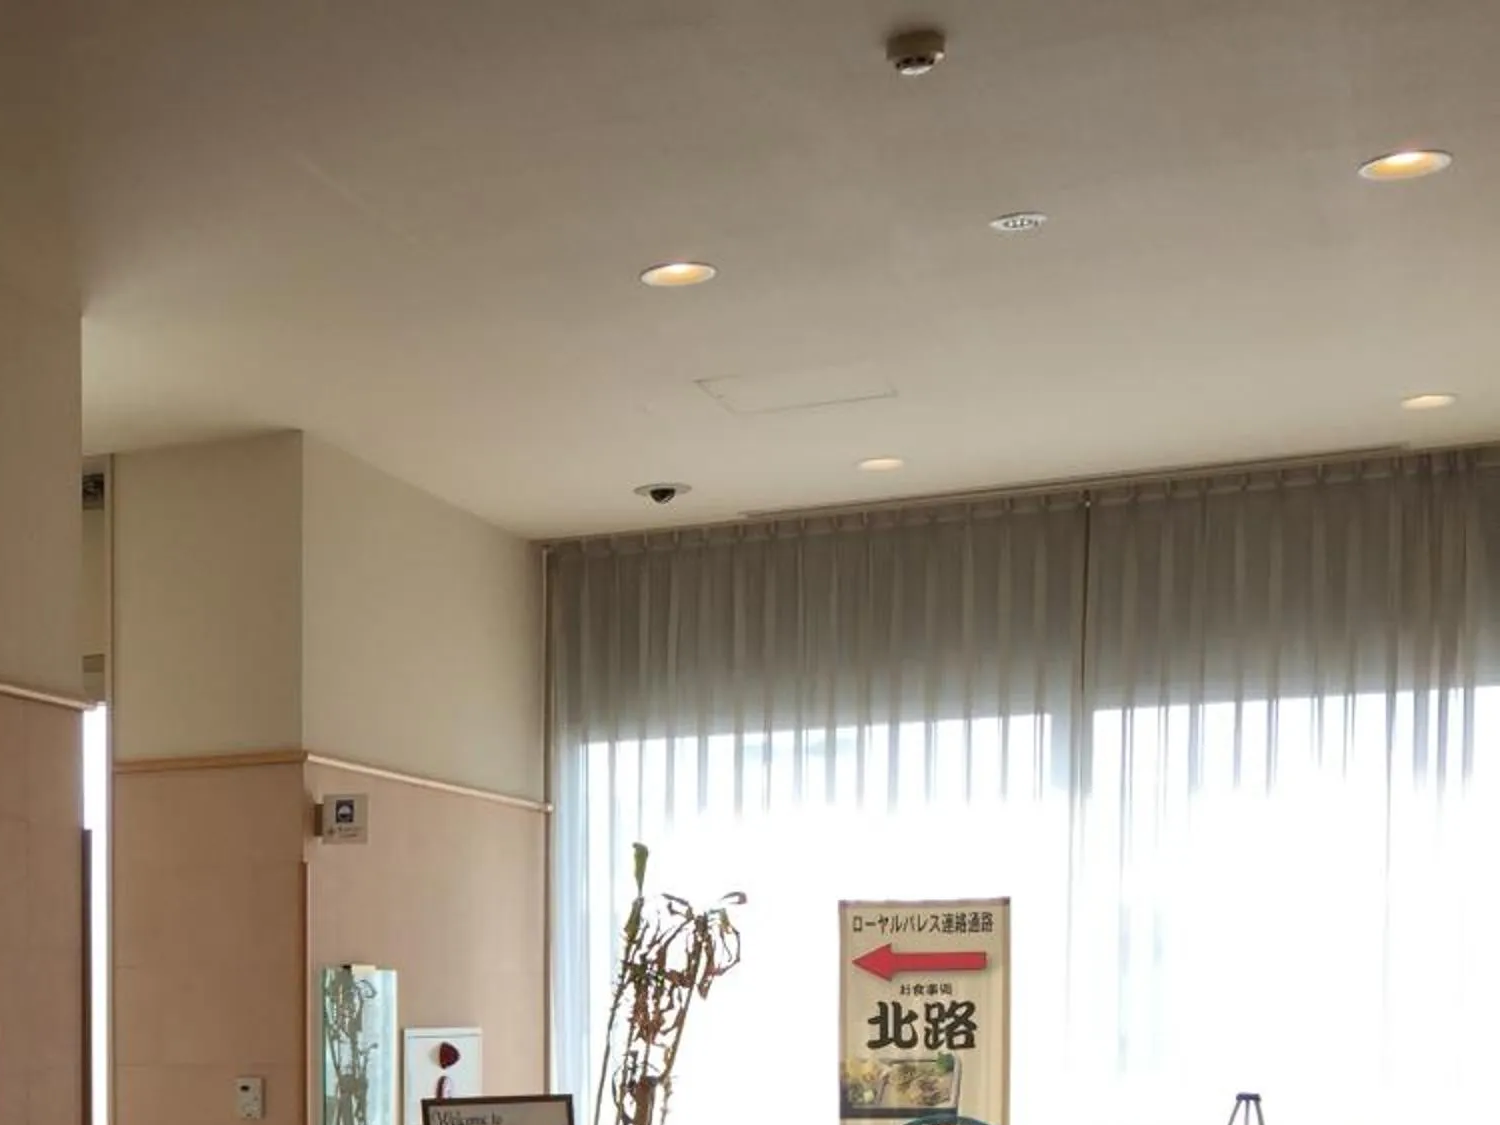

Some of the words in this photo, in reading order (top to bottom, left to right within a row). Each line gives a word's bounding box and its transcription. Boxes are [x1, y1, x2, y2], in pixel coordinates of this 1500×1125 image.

[852, 911, 994, 934] ローヤルパレス連絡通路
[866, 1000, 977, 1050] 北路
